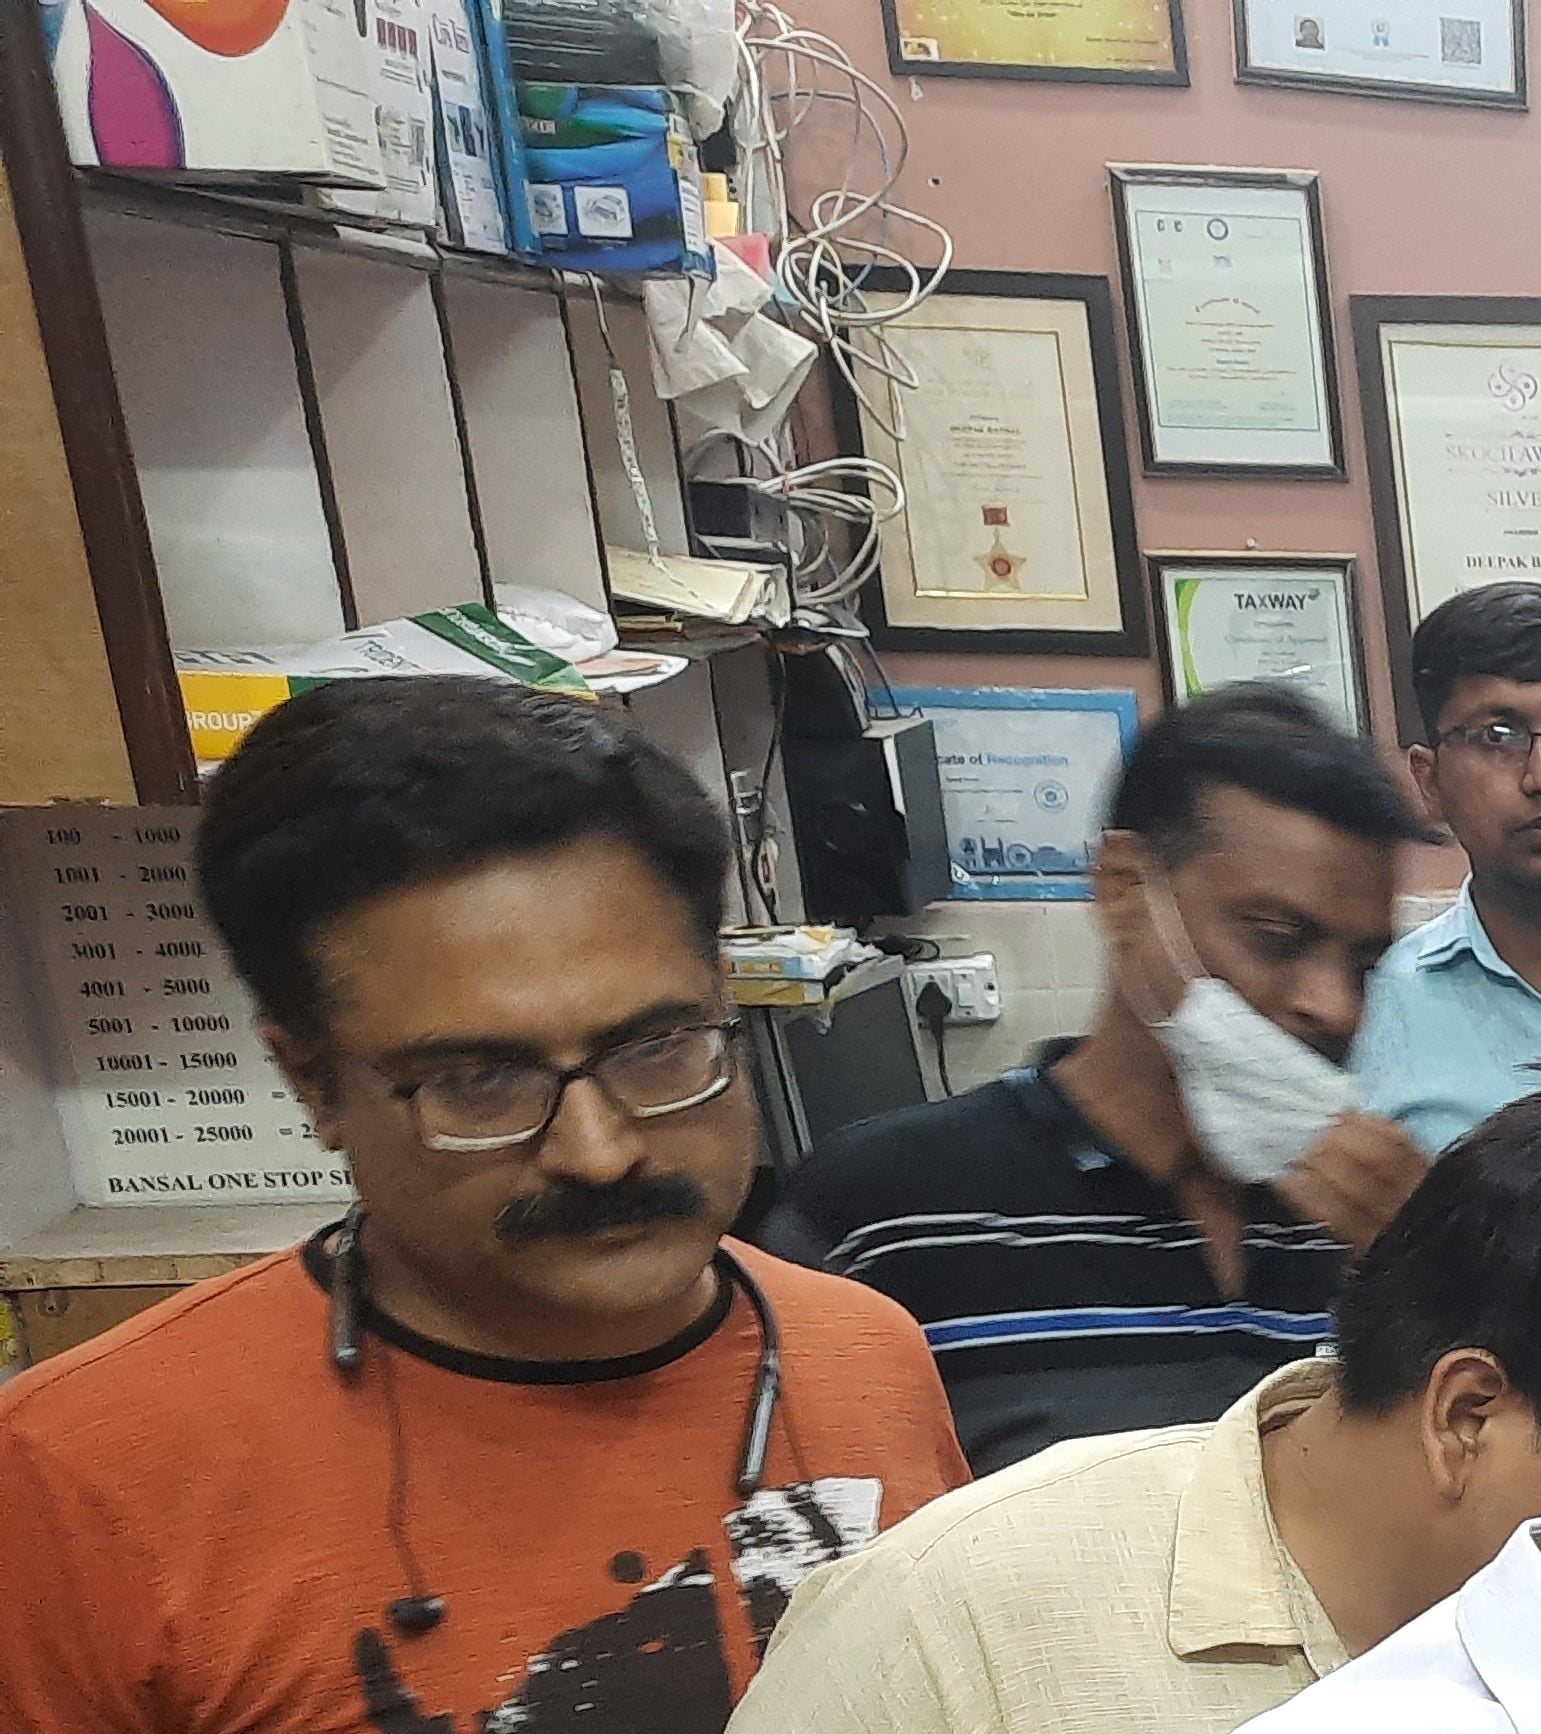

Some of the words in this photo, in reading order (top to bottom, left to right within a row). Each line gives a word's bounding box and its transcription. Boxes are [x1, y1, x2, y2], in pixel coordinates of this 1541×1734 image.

[1466, 556, 1528, 569] DEEPAK
[1234, 593, 1307, 610] TAXWAY
[969, 754, 983, 766] of
[987, 755, 1069, 767] Recognition
[139, 865, 188, 882] 2000
[62, 904, 109, 922] 2001
[145, 903, 195, 921] 3000
[154, 942, 201, 958] 4000
[79, 980, 126, 998] 4001
[163, 979, 210, 996] 5000
[88, 1017, 134, 1035] 5001
[171, 1015, 231, 1034] 10000
[193, 1124, 254, 1144] 25000
[108, 1174, 202, 1195] BANSAL
[208, 1172, 259, 1190] ONE
[263, 1170, 324, 1189] STOP
